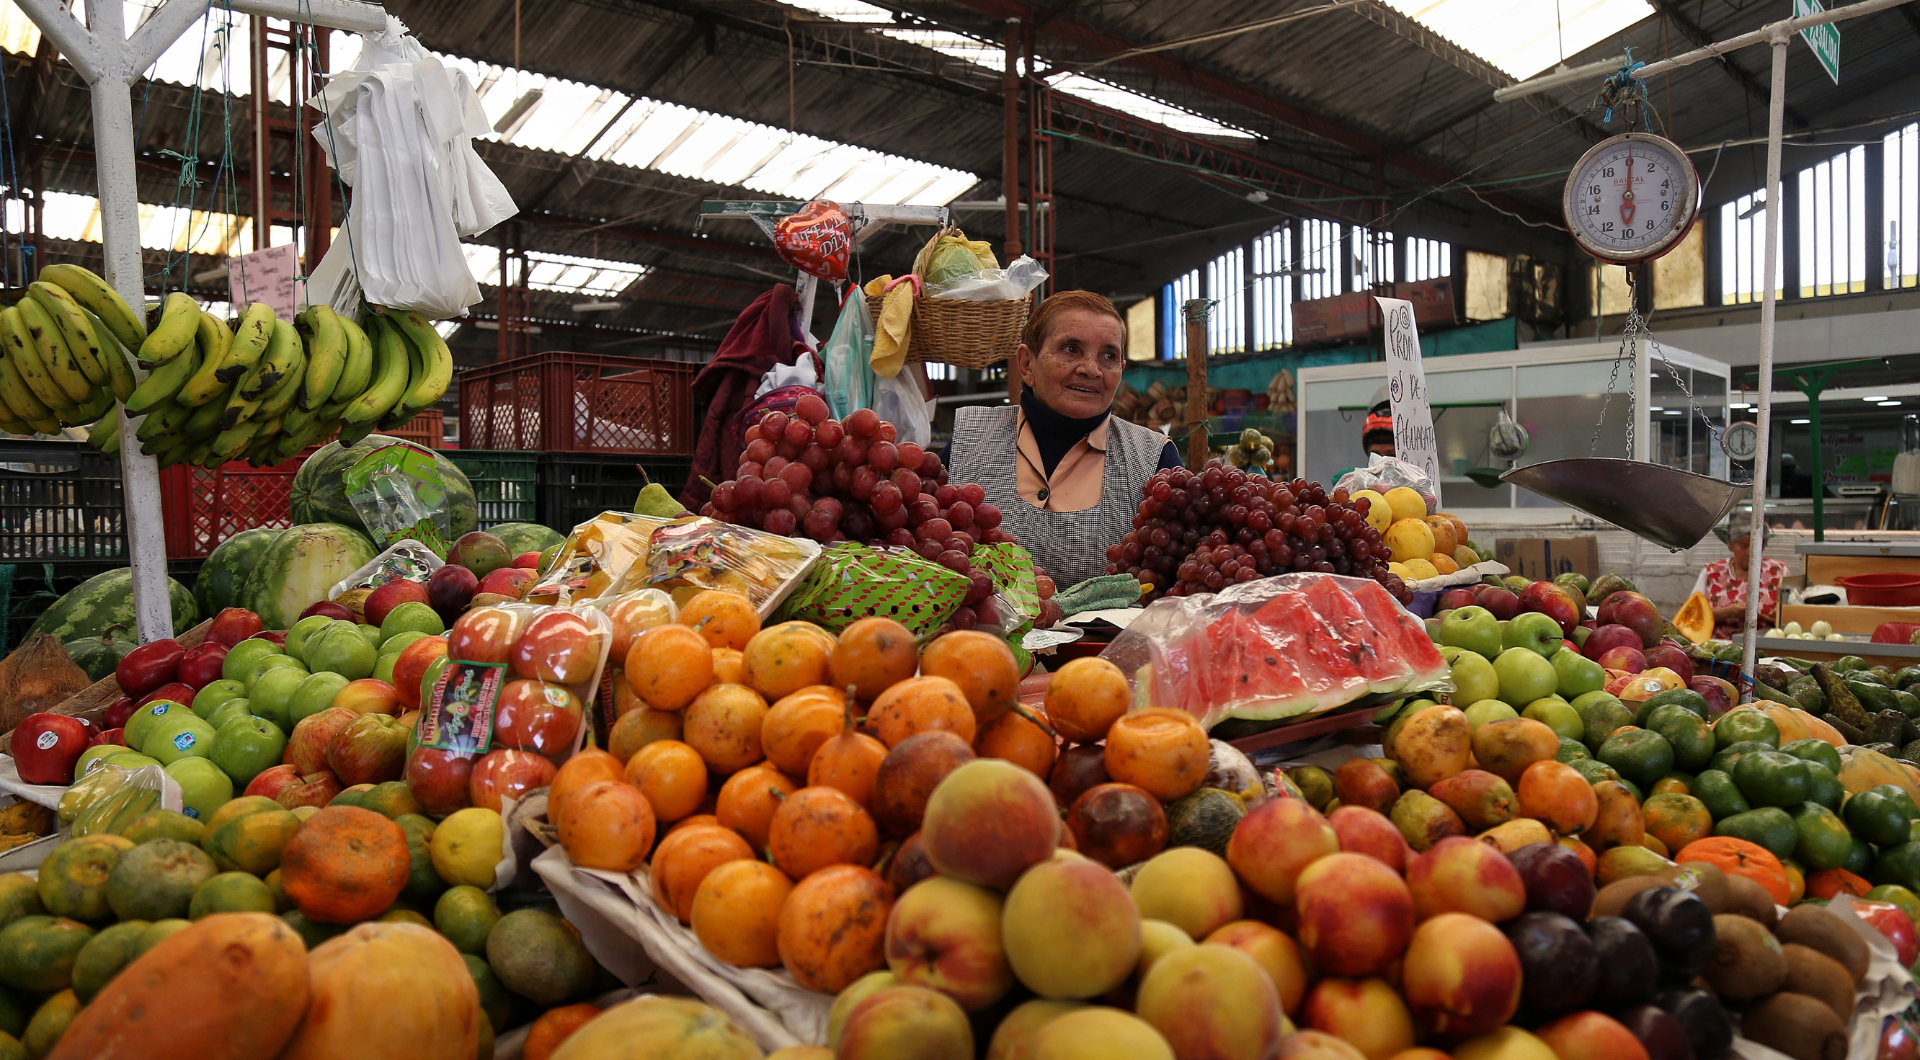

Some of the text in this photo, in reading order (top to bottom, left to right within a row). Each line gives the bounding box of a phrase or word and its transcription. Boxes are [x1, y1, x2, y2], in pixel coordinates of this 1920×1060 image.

[1819, 24, 1837, 70] SALIDA
[1602, 168, 1615, 178] 18
[1647, 163, 1655, 173] 2
[1661, 179, 1669, 188] 4
[1589, 185, 1601, 195] 16
[1588, 205, 1600, 215] 14
[1661, 201, 1669, 210] 6
[1602, 222, 1614, 232] 12
[1646, 220, 1654, 230] 8
[1621, 229, 1634, 239] 10
